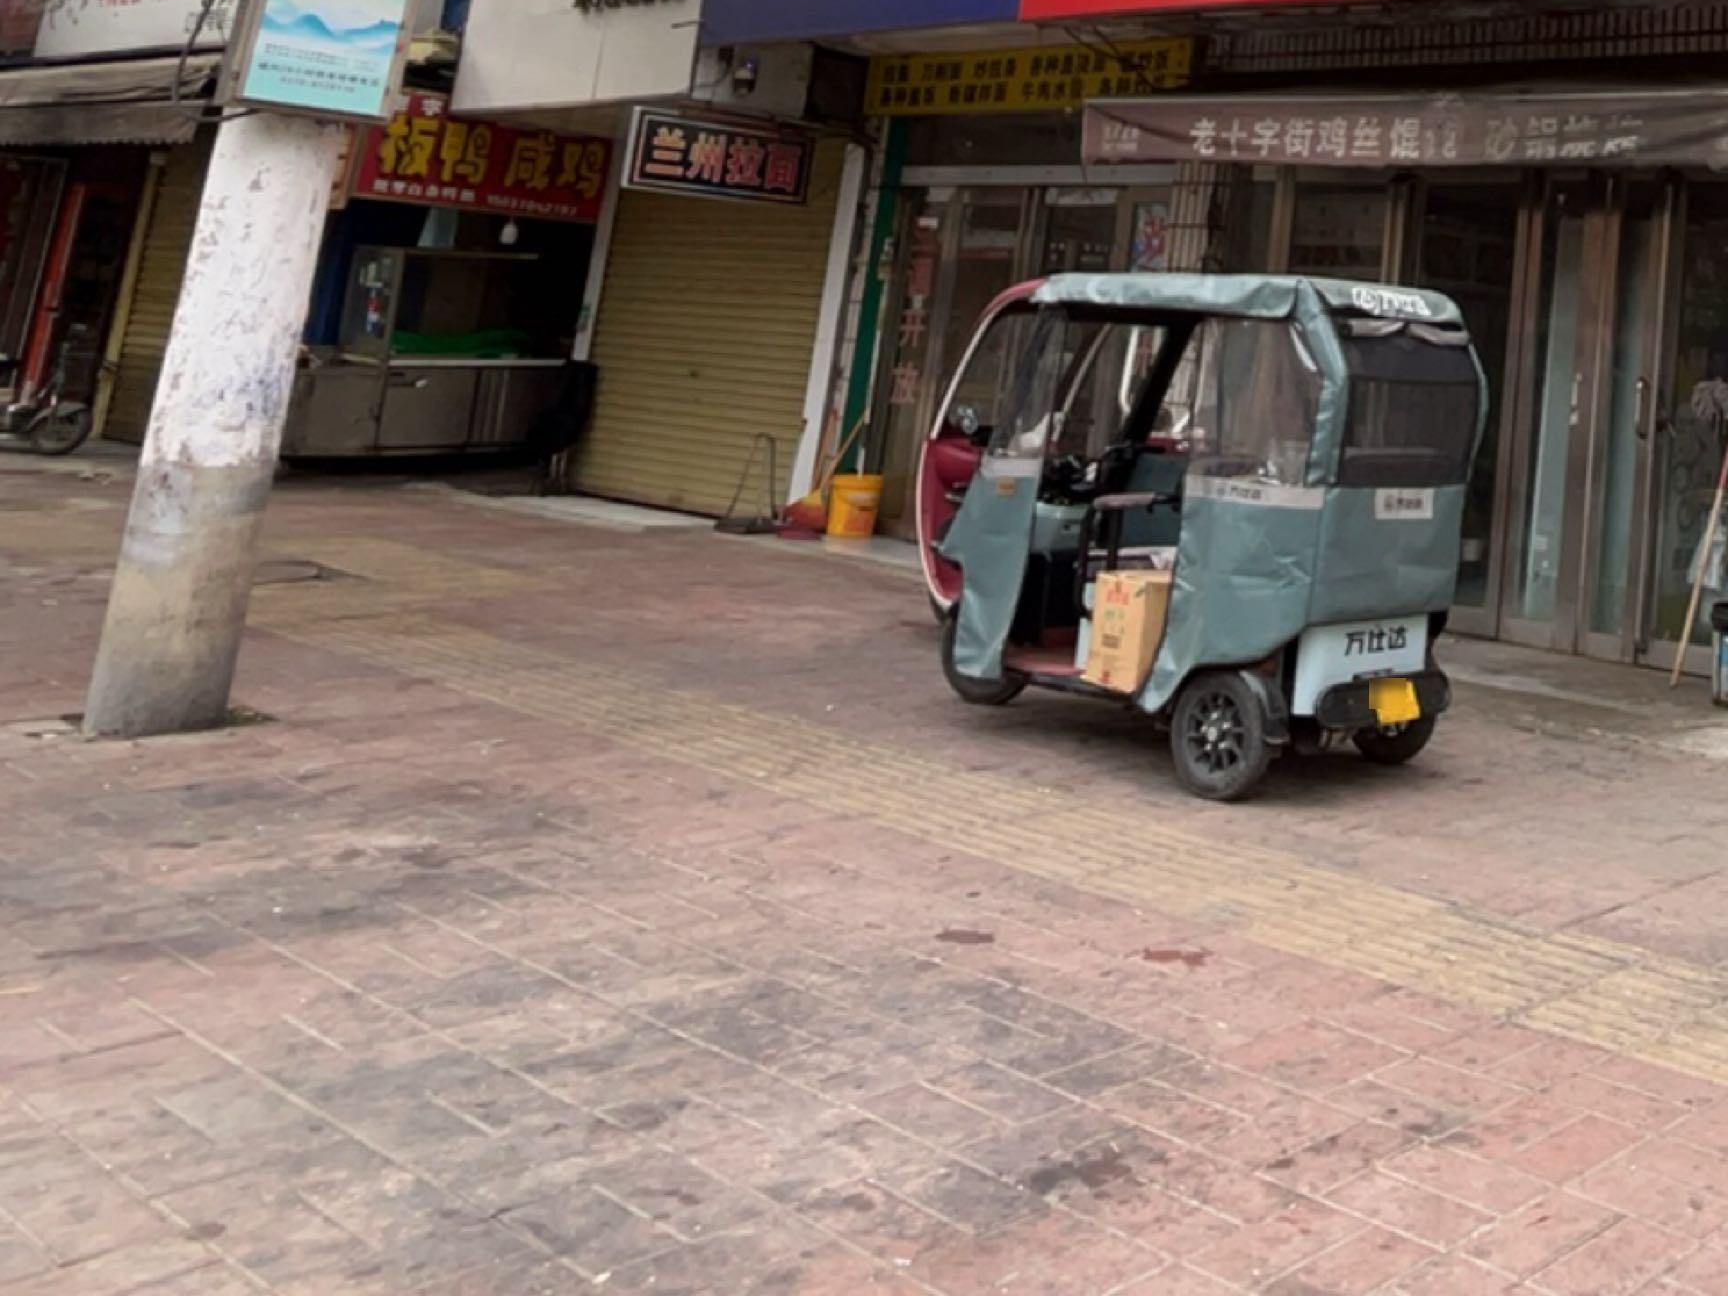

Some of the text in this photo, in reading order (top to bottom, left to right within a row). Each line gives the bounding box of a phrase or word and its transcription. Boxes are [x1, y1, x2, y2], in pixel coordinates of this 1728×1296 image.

[646, 127, 799, 195] 兰州拉面
[1344, 624, 1408, 657] 万仕达
